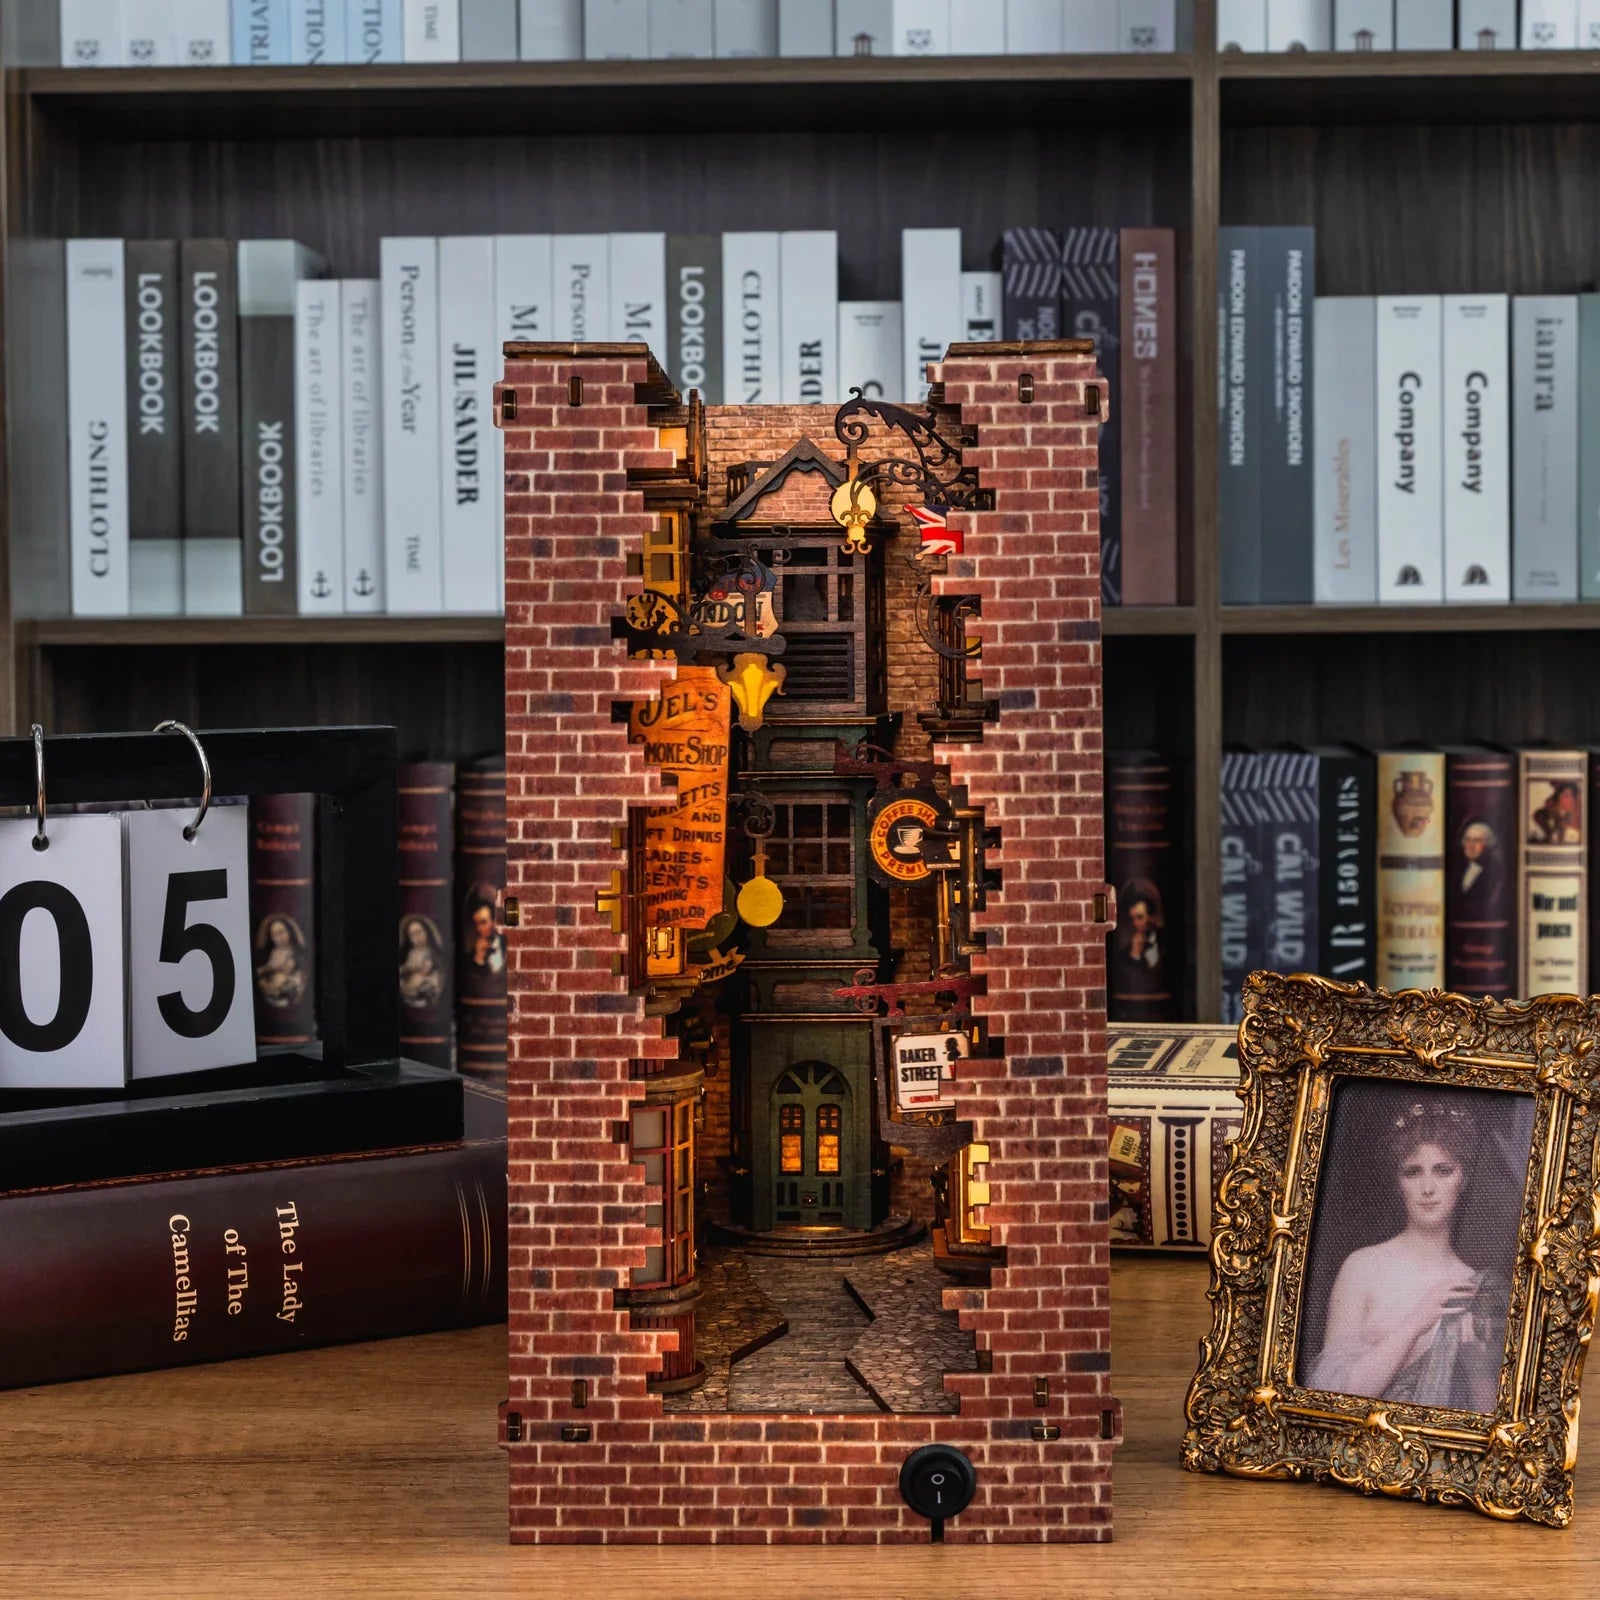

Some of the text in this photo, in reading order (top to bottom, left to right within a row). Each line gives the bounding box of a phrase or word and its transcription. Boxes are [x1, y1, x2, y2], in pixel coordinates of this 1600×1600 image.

[308, 300, 324, 340] The
[350, 297, 368, 338] The
[400, 265, 420, 345] Person
[1133, 252, 1157, 359] HOMES
[137, 274, 164, 434] LOOKBOOK
[193, 272, 219, 433] LOOKBOOK
[308, 347, 323, 375] art
[351, 346, 367, 374] art
[1230, 317, 1245, 384] EDWARD
[1287, 317, 1302, 384] EDWARD
[401, 383, 421, 435] Year
[453, 343, 479, 506] JIL SANDER
[1229, 386, 1245, 466] SNOWDEN
[1287, 386, 1302, 466] SNOWDEN
[1394, 371, 1421, 494] Company
[1461, 371, 1488, 494] Company
[310, 411, 328, 498] libraries
[353, 410, 371, 497] libraries
[89, 421, 110, 578] CLOTHING
[259, 421, 284, 582] LOOKBOOK
[691, 812, 721, 823] AND
[877, 804, 914, 838] COFFEE
[659, 863, 686, 873] AND
[1276, 834, 1305, 966] CAL WILD
[1337, 862, 1360, 907] 150
[157, 868, 236, 1039] 5
[1222, 893, 1248, 967] WILD
[900, 1048, 937, 1063] BAKER
[901, 1065, 943, 1082] STREET
[168, 1214, 197, 1342] Camellias
[223, 1228, 249, 1316] of The
[276, 1201, 303, 1323] The Lady
